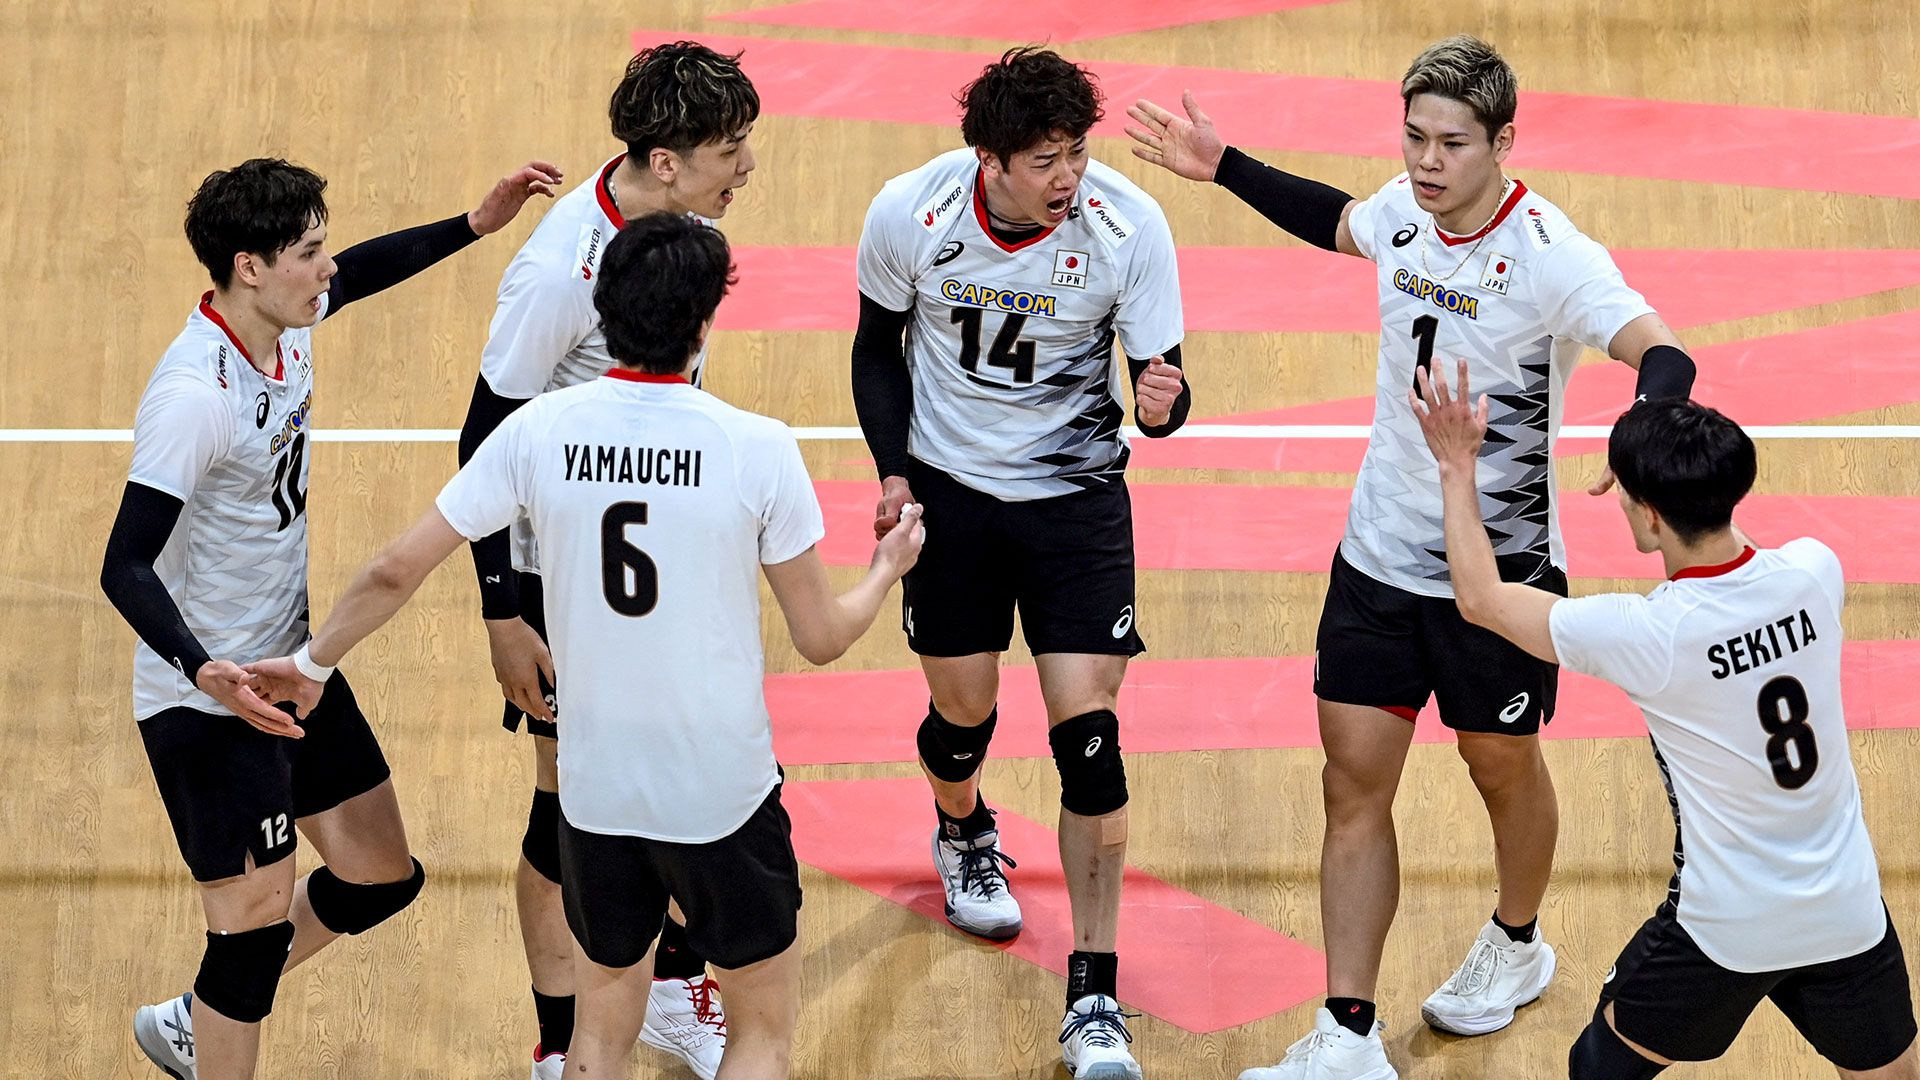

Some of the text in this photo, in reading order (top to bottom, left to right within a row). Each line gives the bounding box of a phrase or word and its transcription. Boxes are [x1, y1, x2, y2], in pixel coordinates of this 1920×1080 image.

[935, 186, 962, 217] POWER
[1096, 209, 1126, 239] POWER
[1532, 218, 1551, 245] POWER
[587, 228, 601, 267] POWER
[940, 278, 1057, 317] CAPCOM
[1057, 274, 1080, 286] JPN
[1393, 268, 1480, 320] CAPCOM
[1485, 278, 1505, 291] JPN
[218, 344, 227, 379] POWER
[950, 306, 1036, 384] 14
[1411, 313, 1440, 401] 1
[564, 444, 702, 487] YAMAUCHI
[601, 500, 659, 618] 6
[485, 574, 501, 584] 2
[1707, 608, 1818, 680] SEKITA
[1757, 674, 1819, 790] 8
[261, 812, 289, 849] 12
